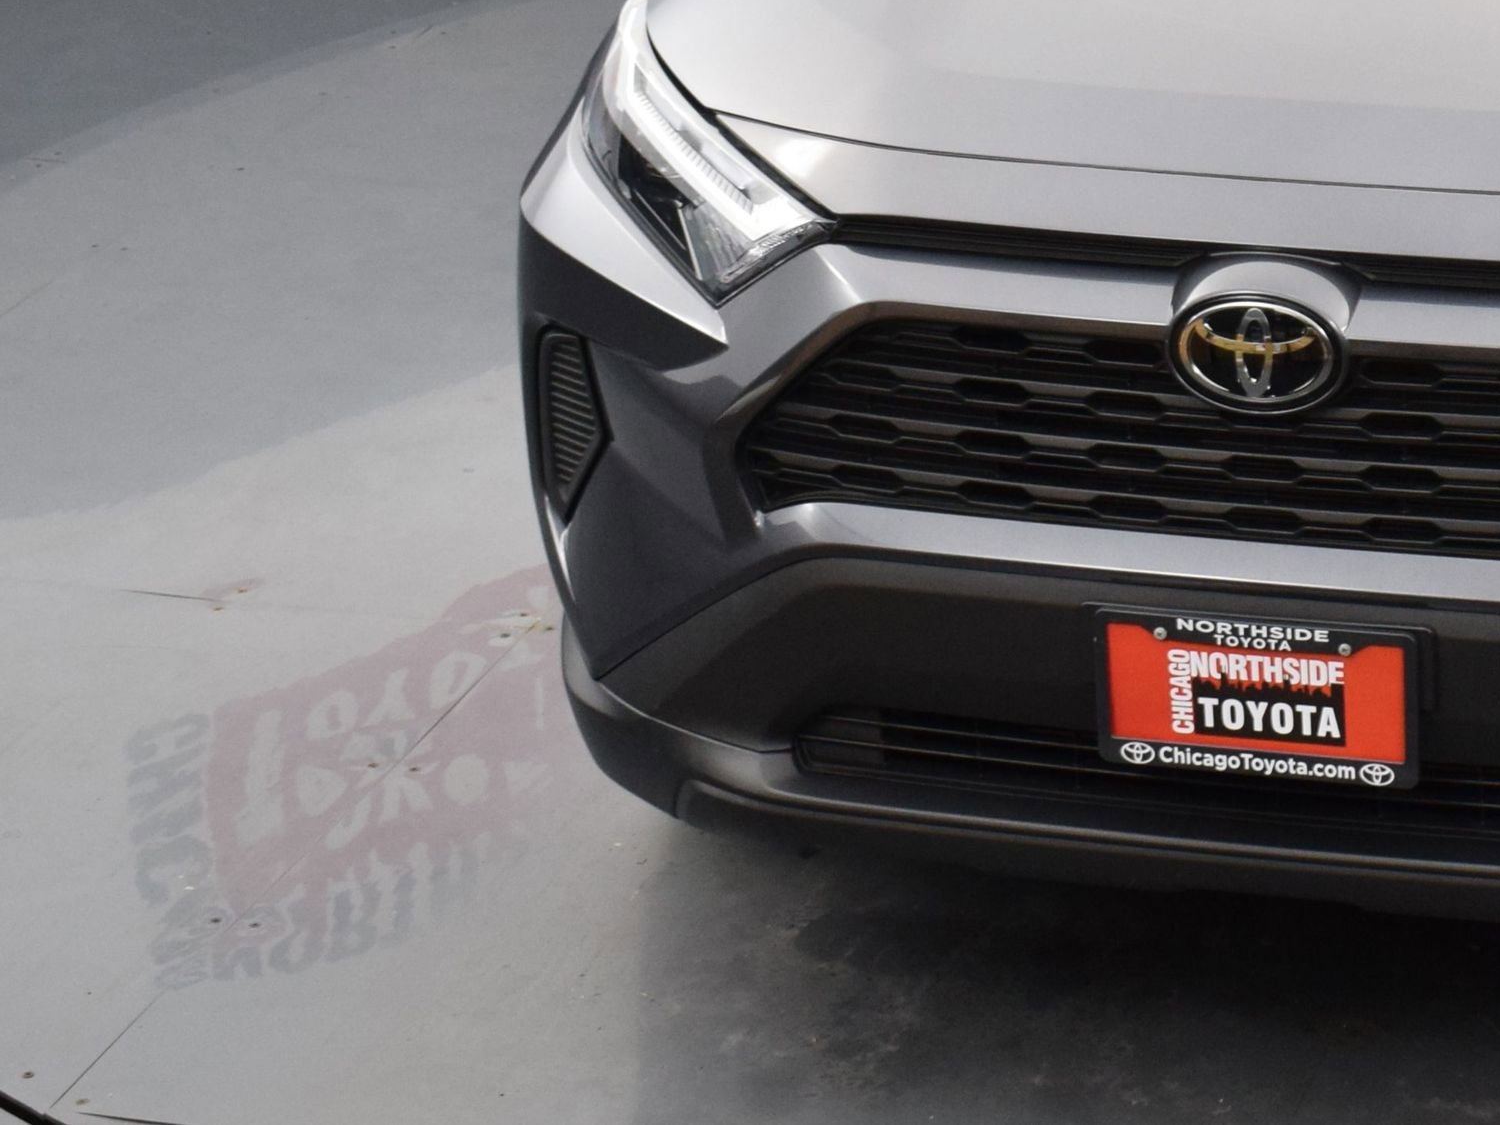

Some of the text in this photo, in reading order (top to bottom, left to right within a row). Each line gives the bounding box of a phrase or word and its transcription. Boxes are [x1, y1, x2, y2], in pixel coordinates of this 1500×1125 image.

[1176, 618, 1329, 642] NORTHSIDE
[1213, 634, 1292, 651] TOYOTA
[1189, 651, 1345, 687] NORTHSIDE
[1167, 648, 1195, 734] CHICAGO
[1198, 696, 1341, 738] TOYOTA
[1159, 746, 1356, 780] ChicagoToyota.com
